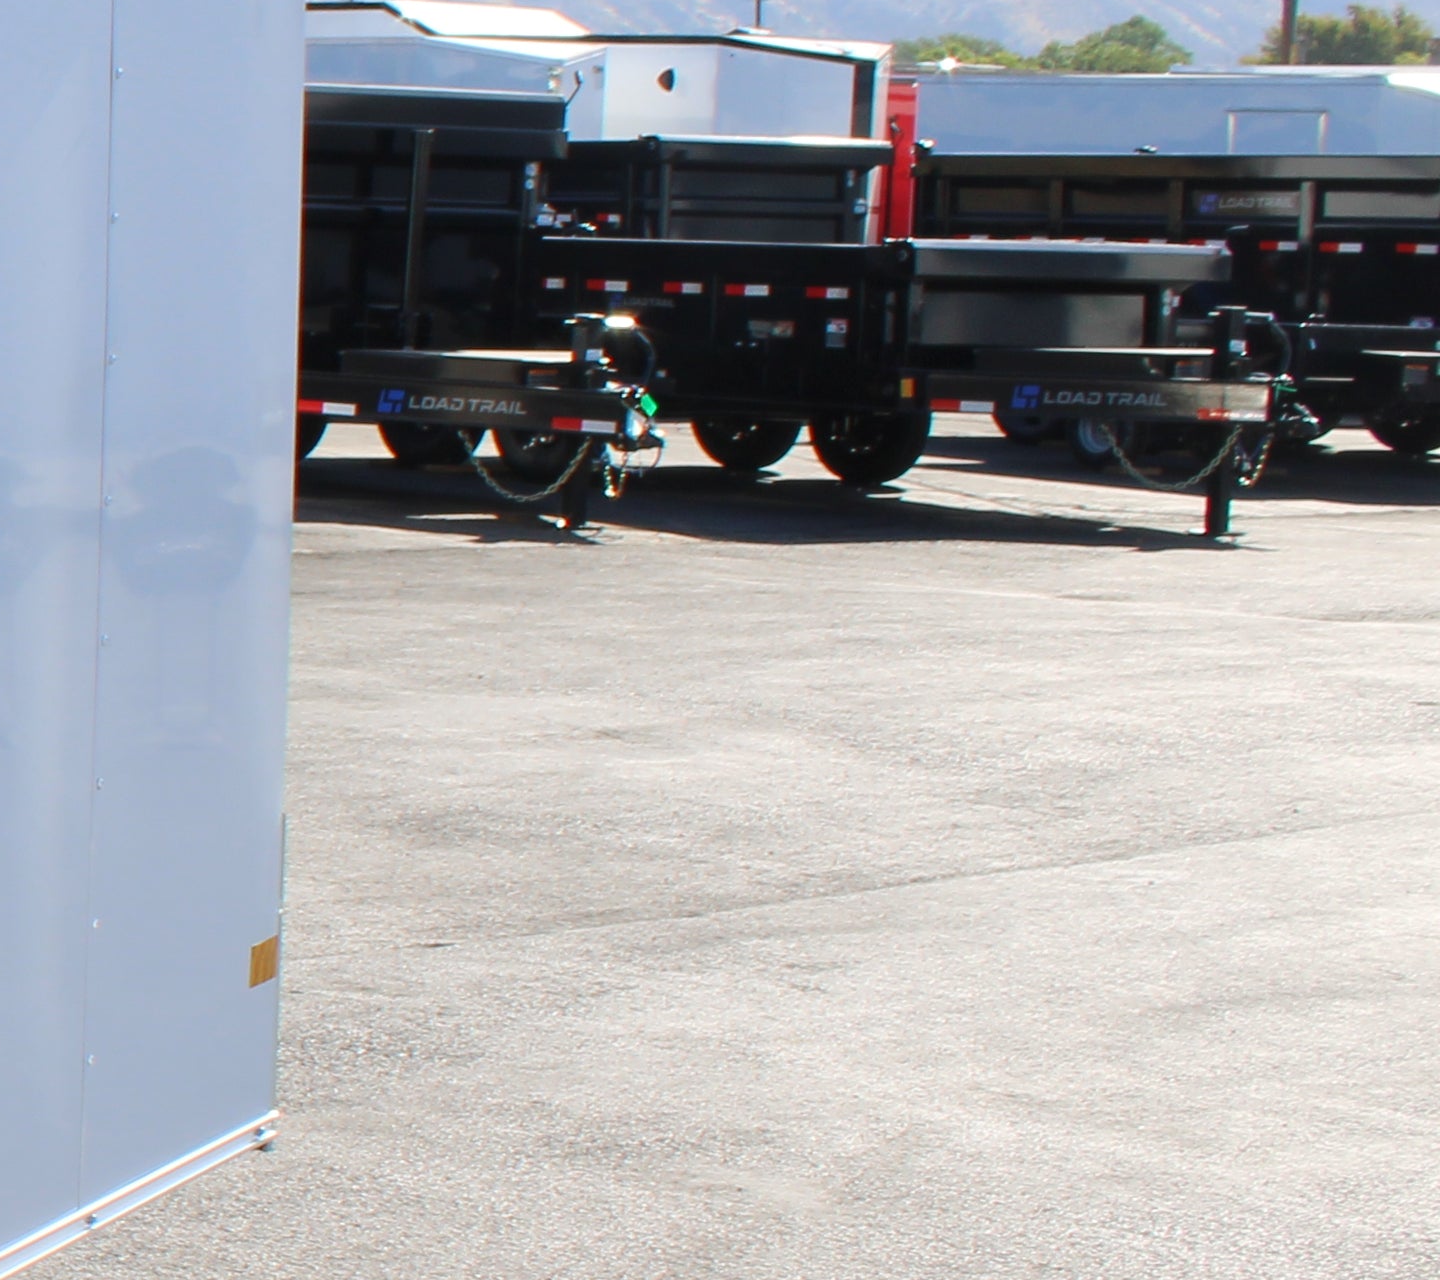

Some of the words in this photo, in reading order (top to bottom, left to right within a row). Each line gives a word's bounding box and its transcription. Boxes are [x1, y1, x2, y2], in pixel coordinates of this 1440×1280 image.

[408, 396, 465, 412] LOAD
[468, 399, 527, 415] TRAIL
[1043, 391, 1101, 405] LOAD
[1106, 392, 1168, 407] TRAIL
